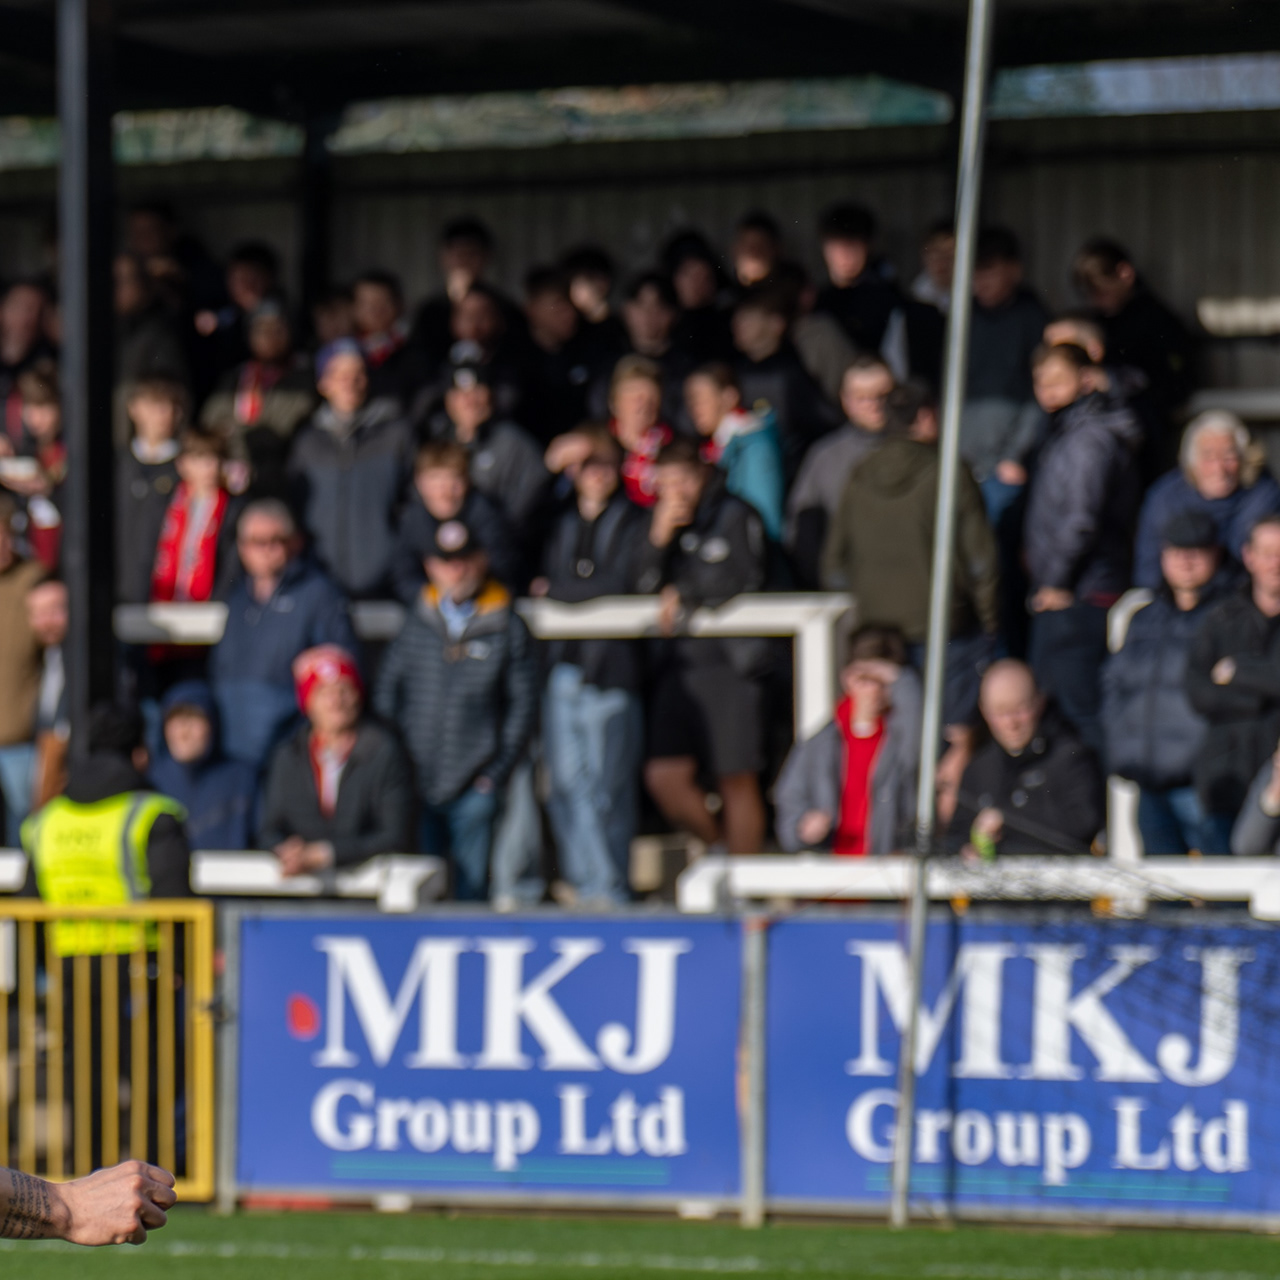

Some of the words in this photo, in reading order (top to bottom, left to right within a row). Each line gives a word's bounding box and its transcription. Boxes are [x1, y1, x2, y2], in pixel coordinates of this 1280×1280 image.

[312, 935, 693, 1074] MKJ
[845, 940, 1256, 1087] MKJ
[311, 1079, 540, 1171] Group
[558, 1084, 687, 1157] Ltd
[846, 1088, 1091, 1186] Group
[1112, 1098, 1251, 1173] Ltd
